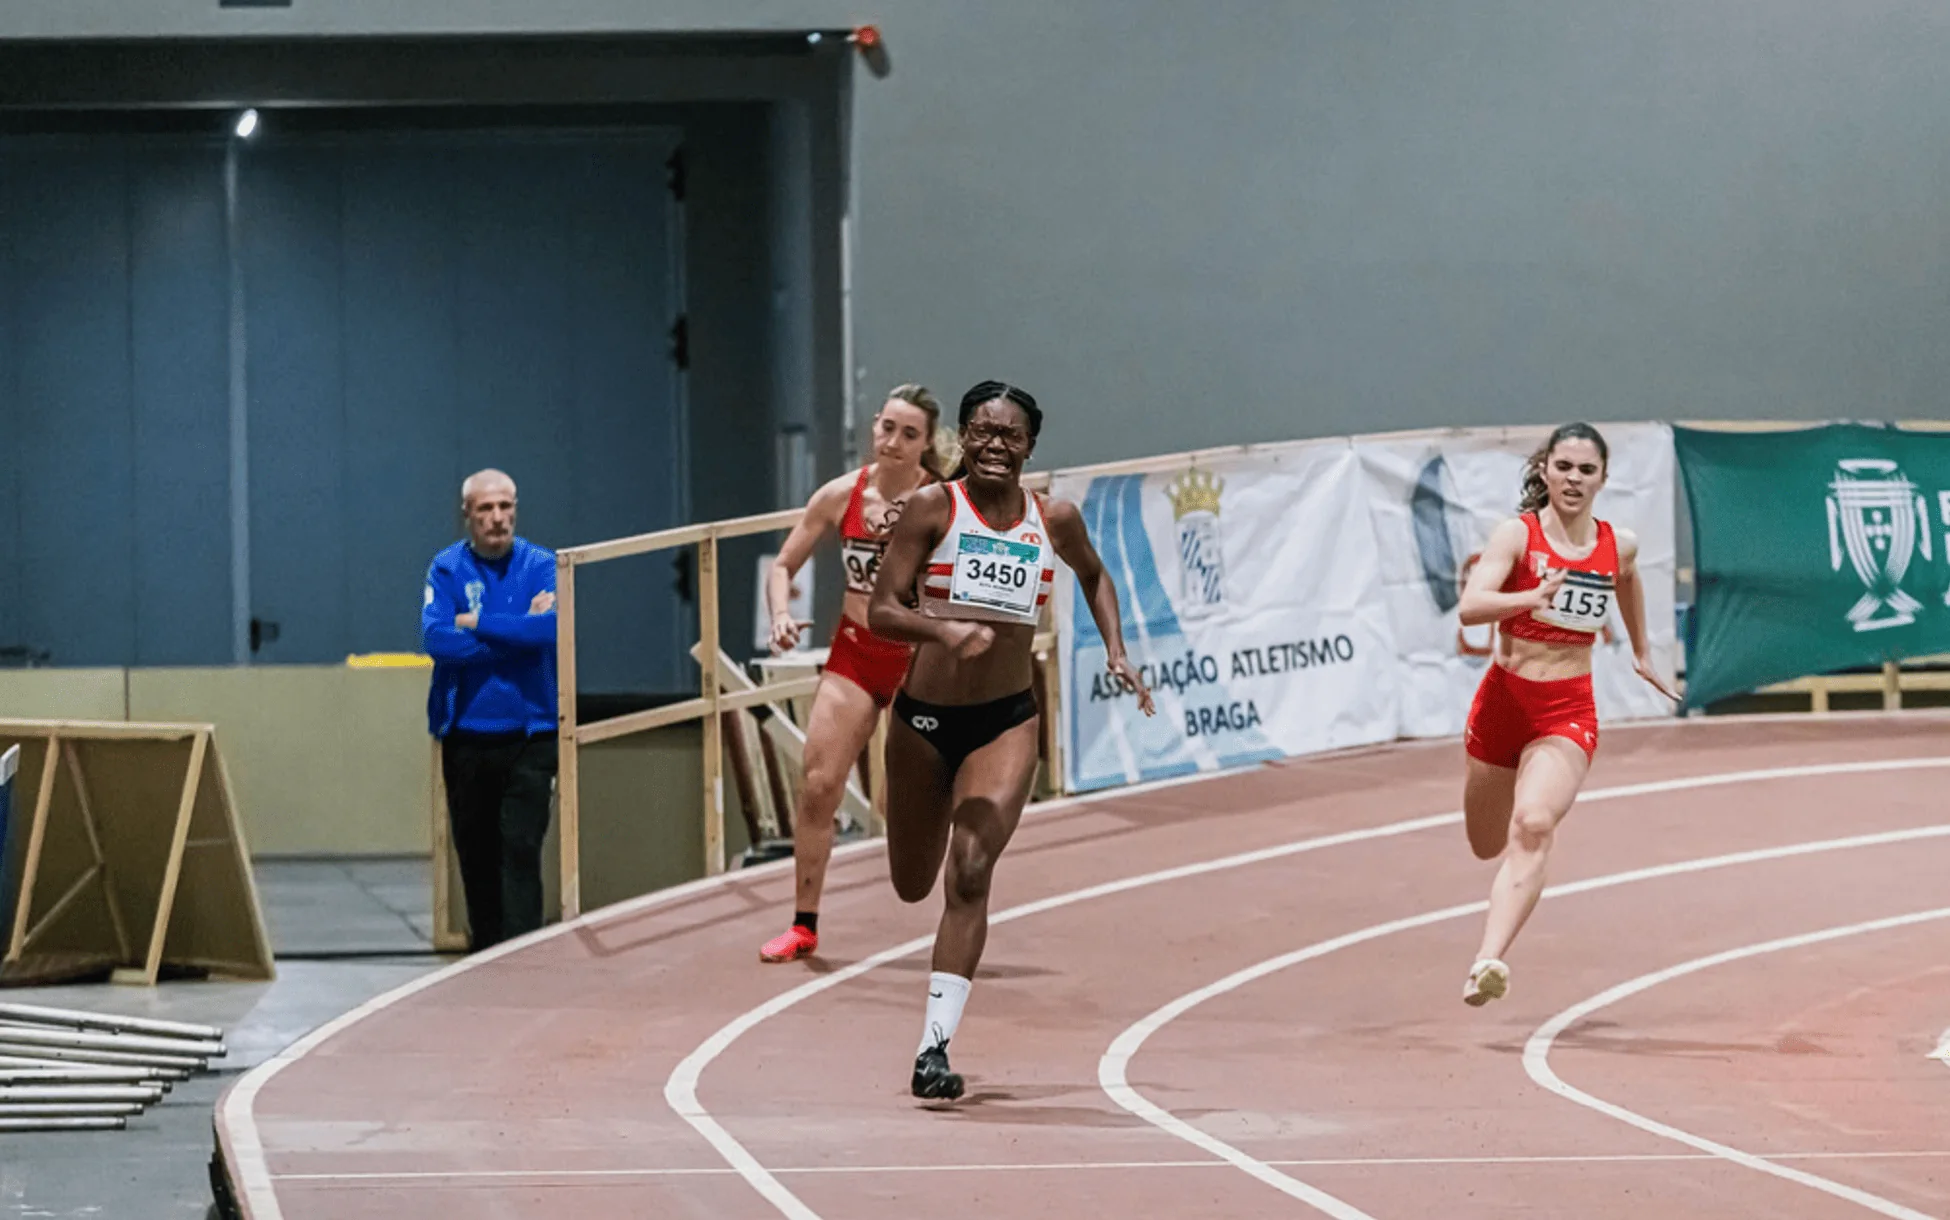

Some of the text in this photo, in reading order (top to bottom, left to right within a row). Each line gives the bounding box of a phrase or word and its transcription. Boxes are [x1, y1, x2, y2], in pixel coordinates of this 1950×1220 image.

[967, 558, 1027, 588] 3450
[1549, 589, 1609, 618] 153
[1231, 634, 1354, 680] ATLETISMO
[1185, 700, 1262, 737] BRAGA
